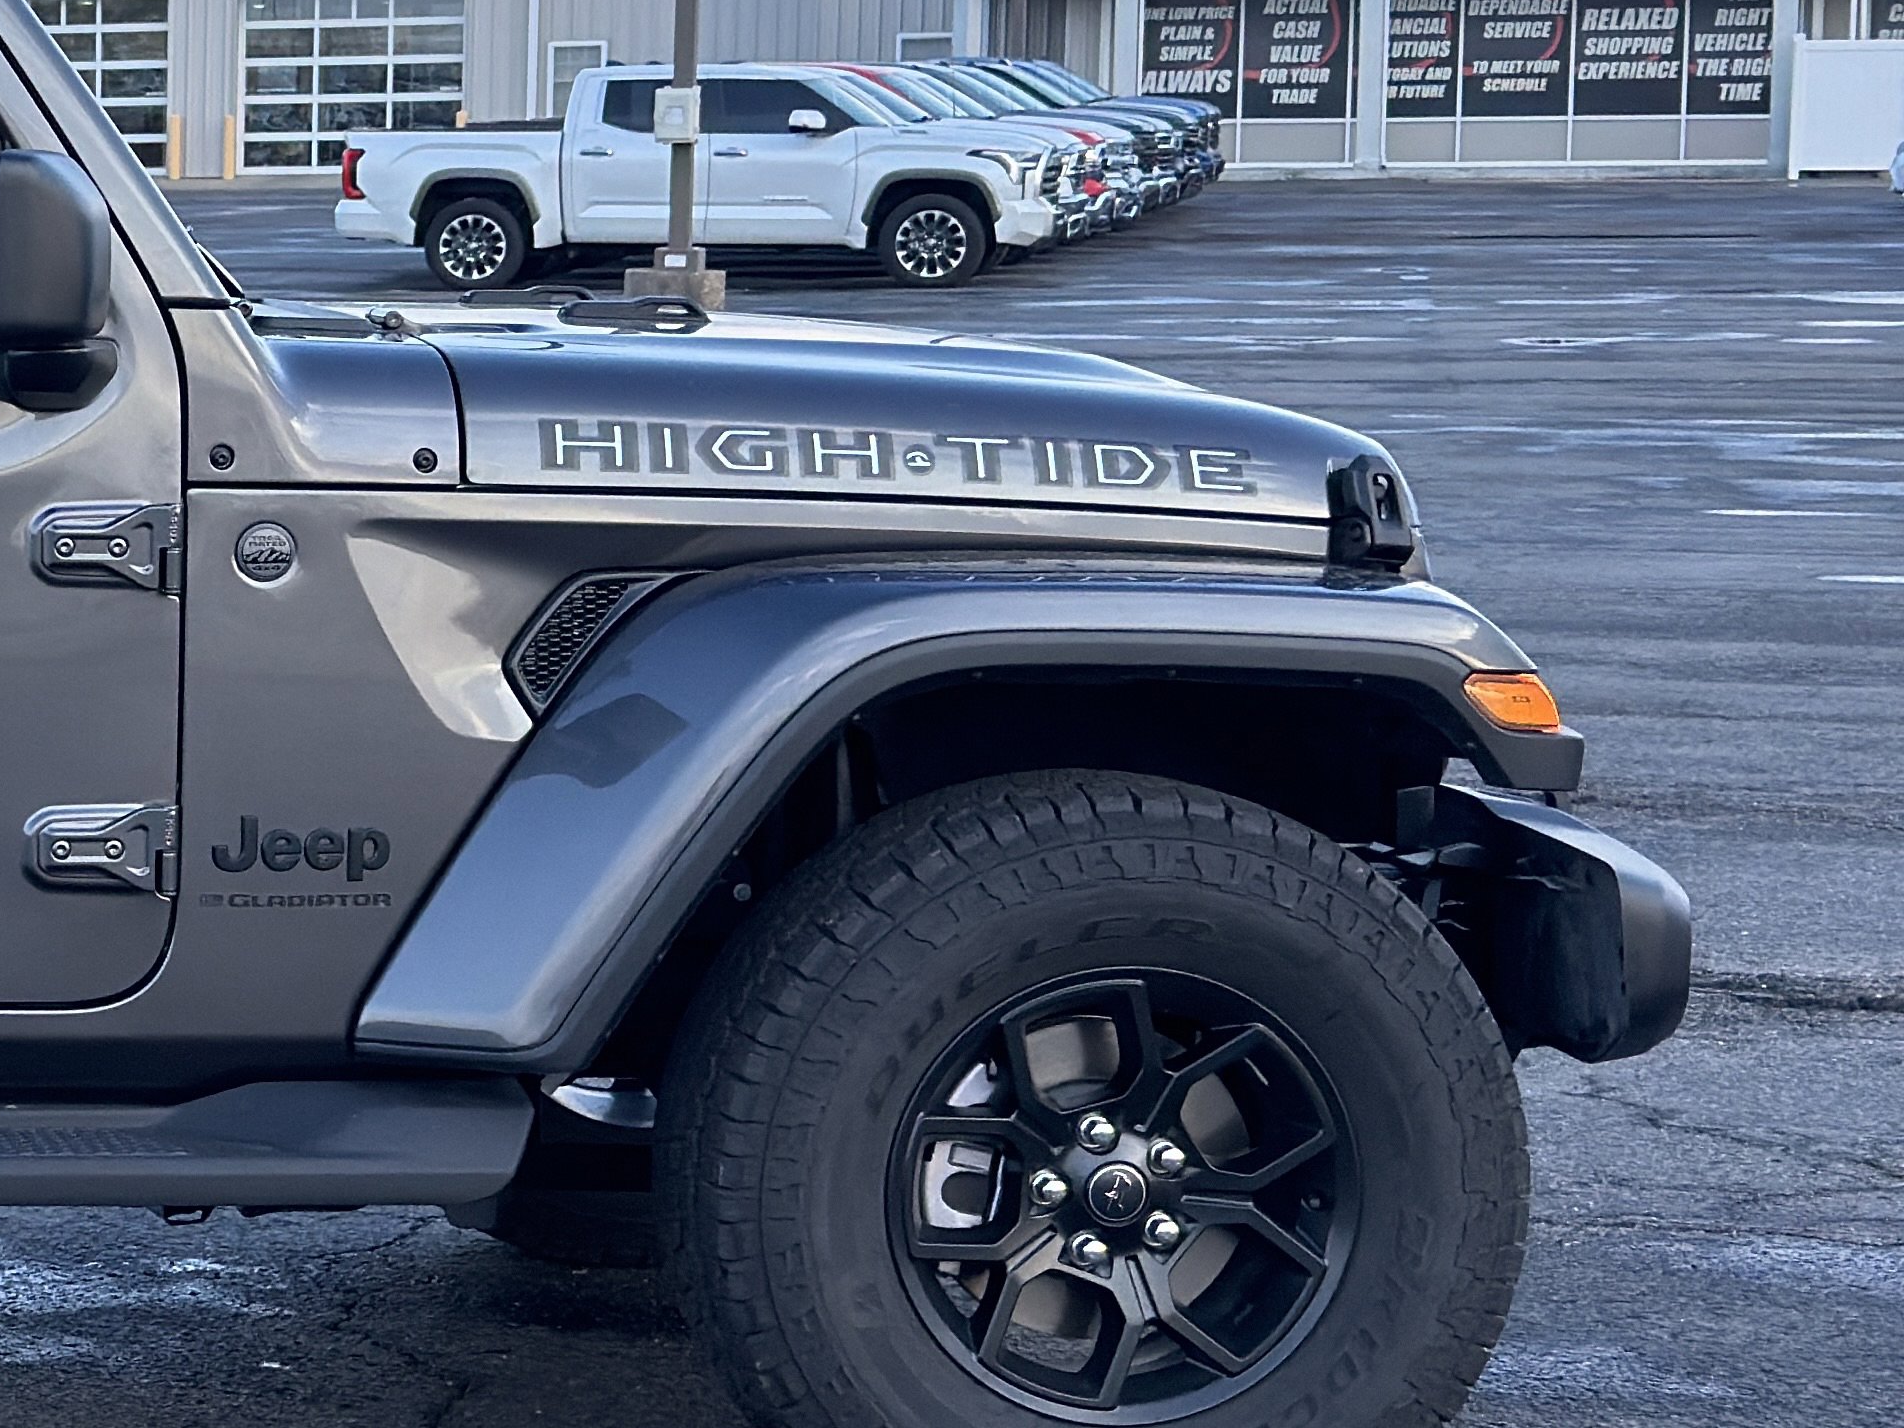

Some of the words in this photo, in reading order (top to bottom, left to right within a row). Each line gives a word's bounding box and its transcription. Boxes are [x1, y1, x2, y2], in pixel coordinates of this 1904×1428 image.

[1168, 7, 1197, 20] LOW
[1198, 6, 1236, 20] PRICE
[1582, 7, 1679, 31] RELAXED
[1714, 8, 1772, 26] RIGHT
[1160, 26, 1203, 41] PLAIN
[1204, 27, 1215, 40] &
[1273, 21, 1321, 39] CASH
[1483, 21, 1553, 39] SERVICE
[1584, 36, 1674, 55] SHOPPING
[1694, 33, 1768, 52] VEHICLE
[1270, 45, 1323, 63] VALUE
[1259, 68, 1288, 84] FOR
[1291, 68, 1330, 84] YOUR
[1424, 66, 1452, 81] AND
[1473, 60, 1489, 74] TO
[1490, 60, 1525, 74] MEET
[1526, 60, 1560, 74] YOUR
[1578, 60, 1681, 80] EXPERIENCE
[1696, 58, 1730, 77] THE
[1142, 69, 1233, 93] ALWAYS
[1482, 78, 1548, 92] SCHEDULE
[1272, 88, 1319, 104] TRADE
[1399, 85, 1447, 99] FUTURE
[1719, 83, 1764, 101] TIME
[538, 418, 895, 481] HIGH
[934, 435, 1258, 497] TIDE
[211, 814, 391, 882] Jeep
[227, 892, 393, 909] GLADIATOR
